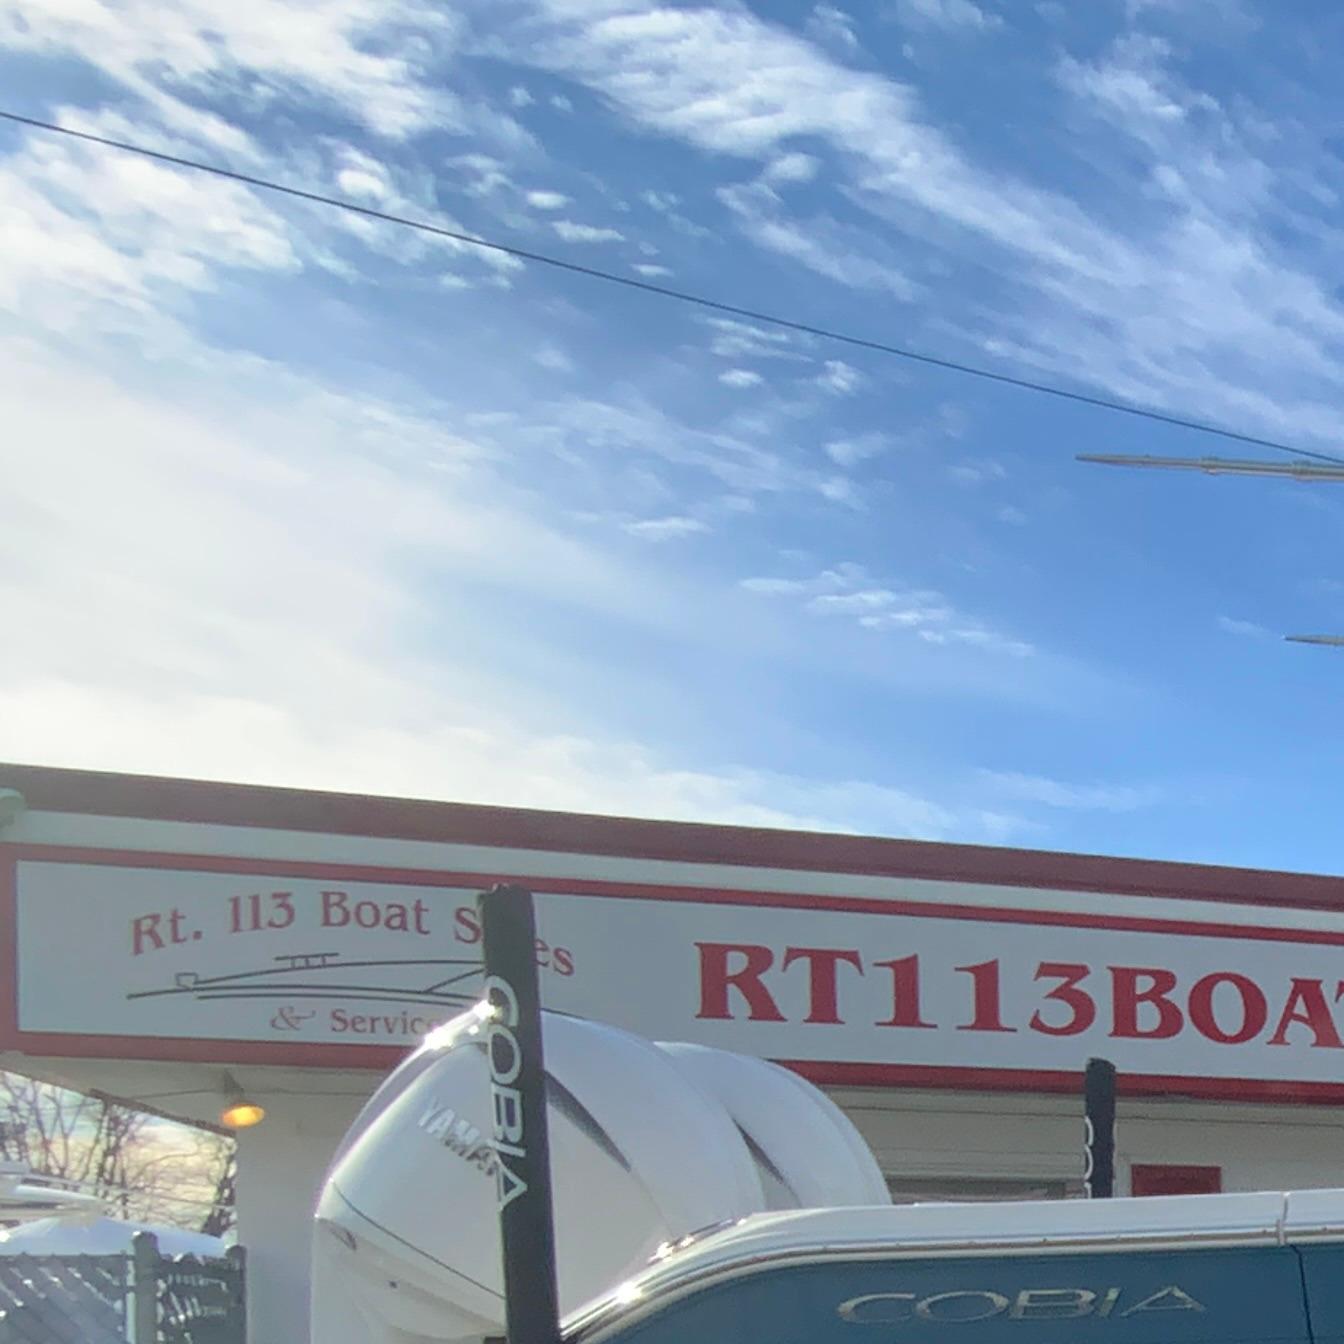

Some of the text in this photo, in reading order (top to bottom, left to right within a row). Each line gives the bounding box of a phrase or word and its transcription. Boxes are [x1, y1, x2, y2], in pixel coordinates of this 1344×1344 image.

[129, 890, 575, 976] Rt. 113 Boat Ses
[270, 1006, 316, 1031] &
[837, 1285, 1206, 1323] COBIA
